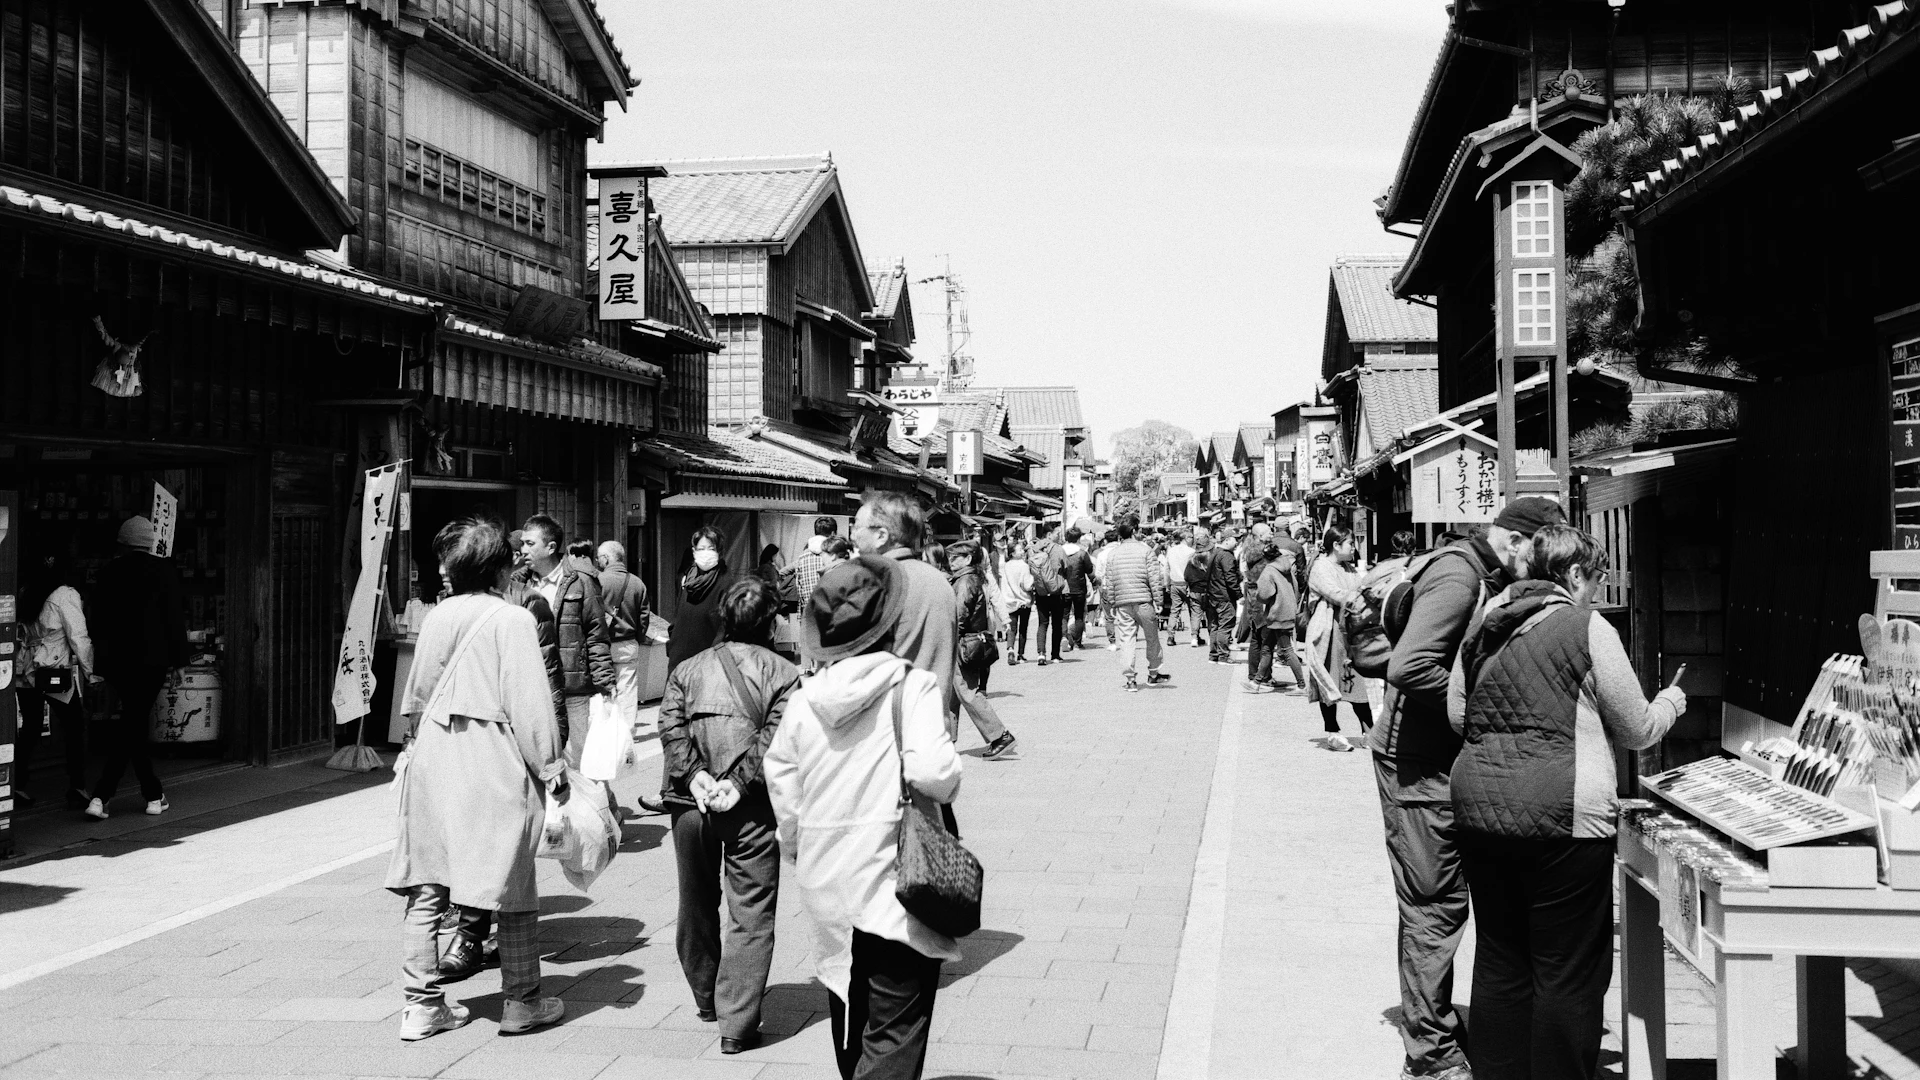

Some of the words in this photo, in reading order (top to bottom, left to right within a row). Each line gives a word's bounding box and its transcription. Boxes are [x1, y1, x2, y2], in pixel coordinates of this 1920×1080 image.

[604, 191, 639, 305] 喜久屋
[884, 388, 932, 400] わらじや
[1455, 453, 1471, 514] もうすぐ
[1476, 451, 1497, 515] おかげ横丁
